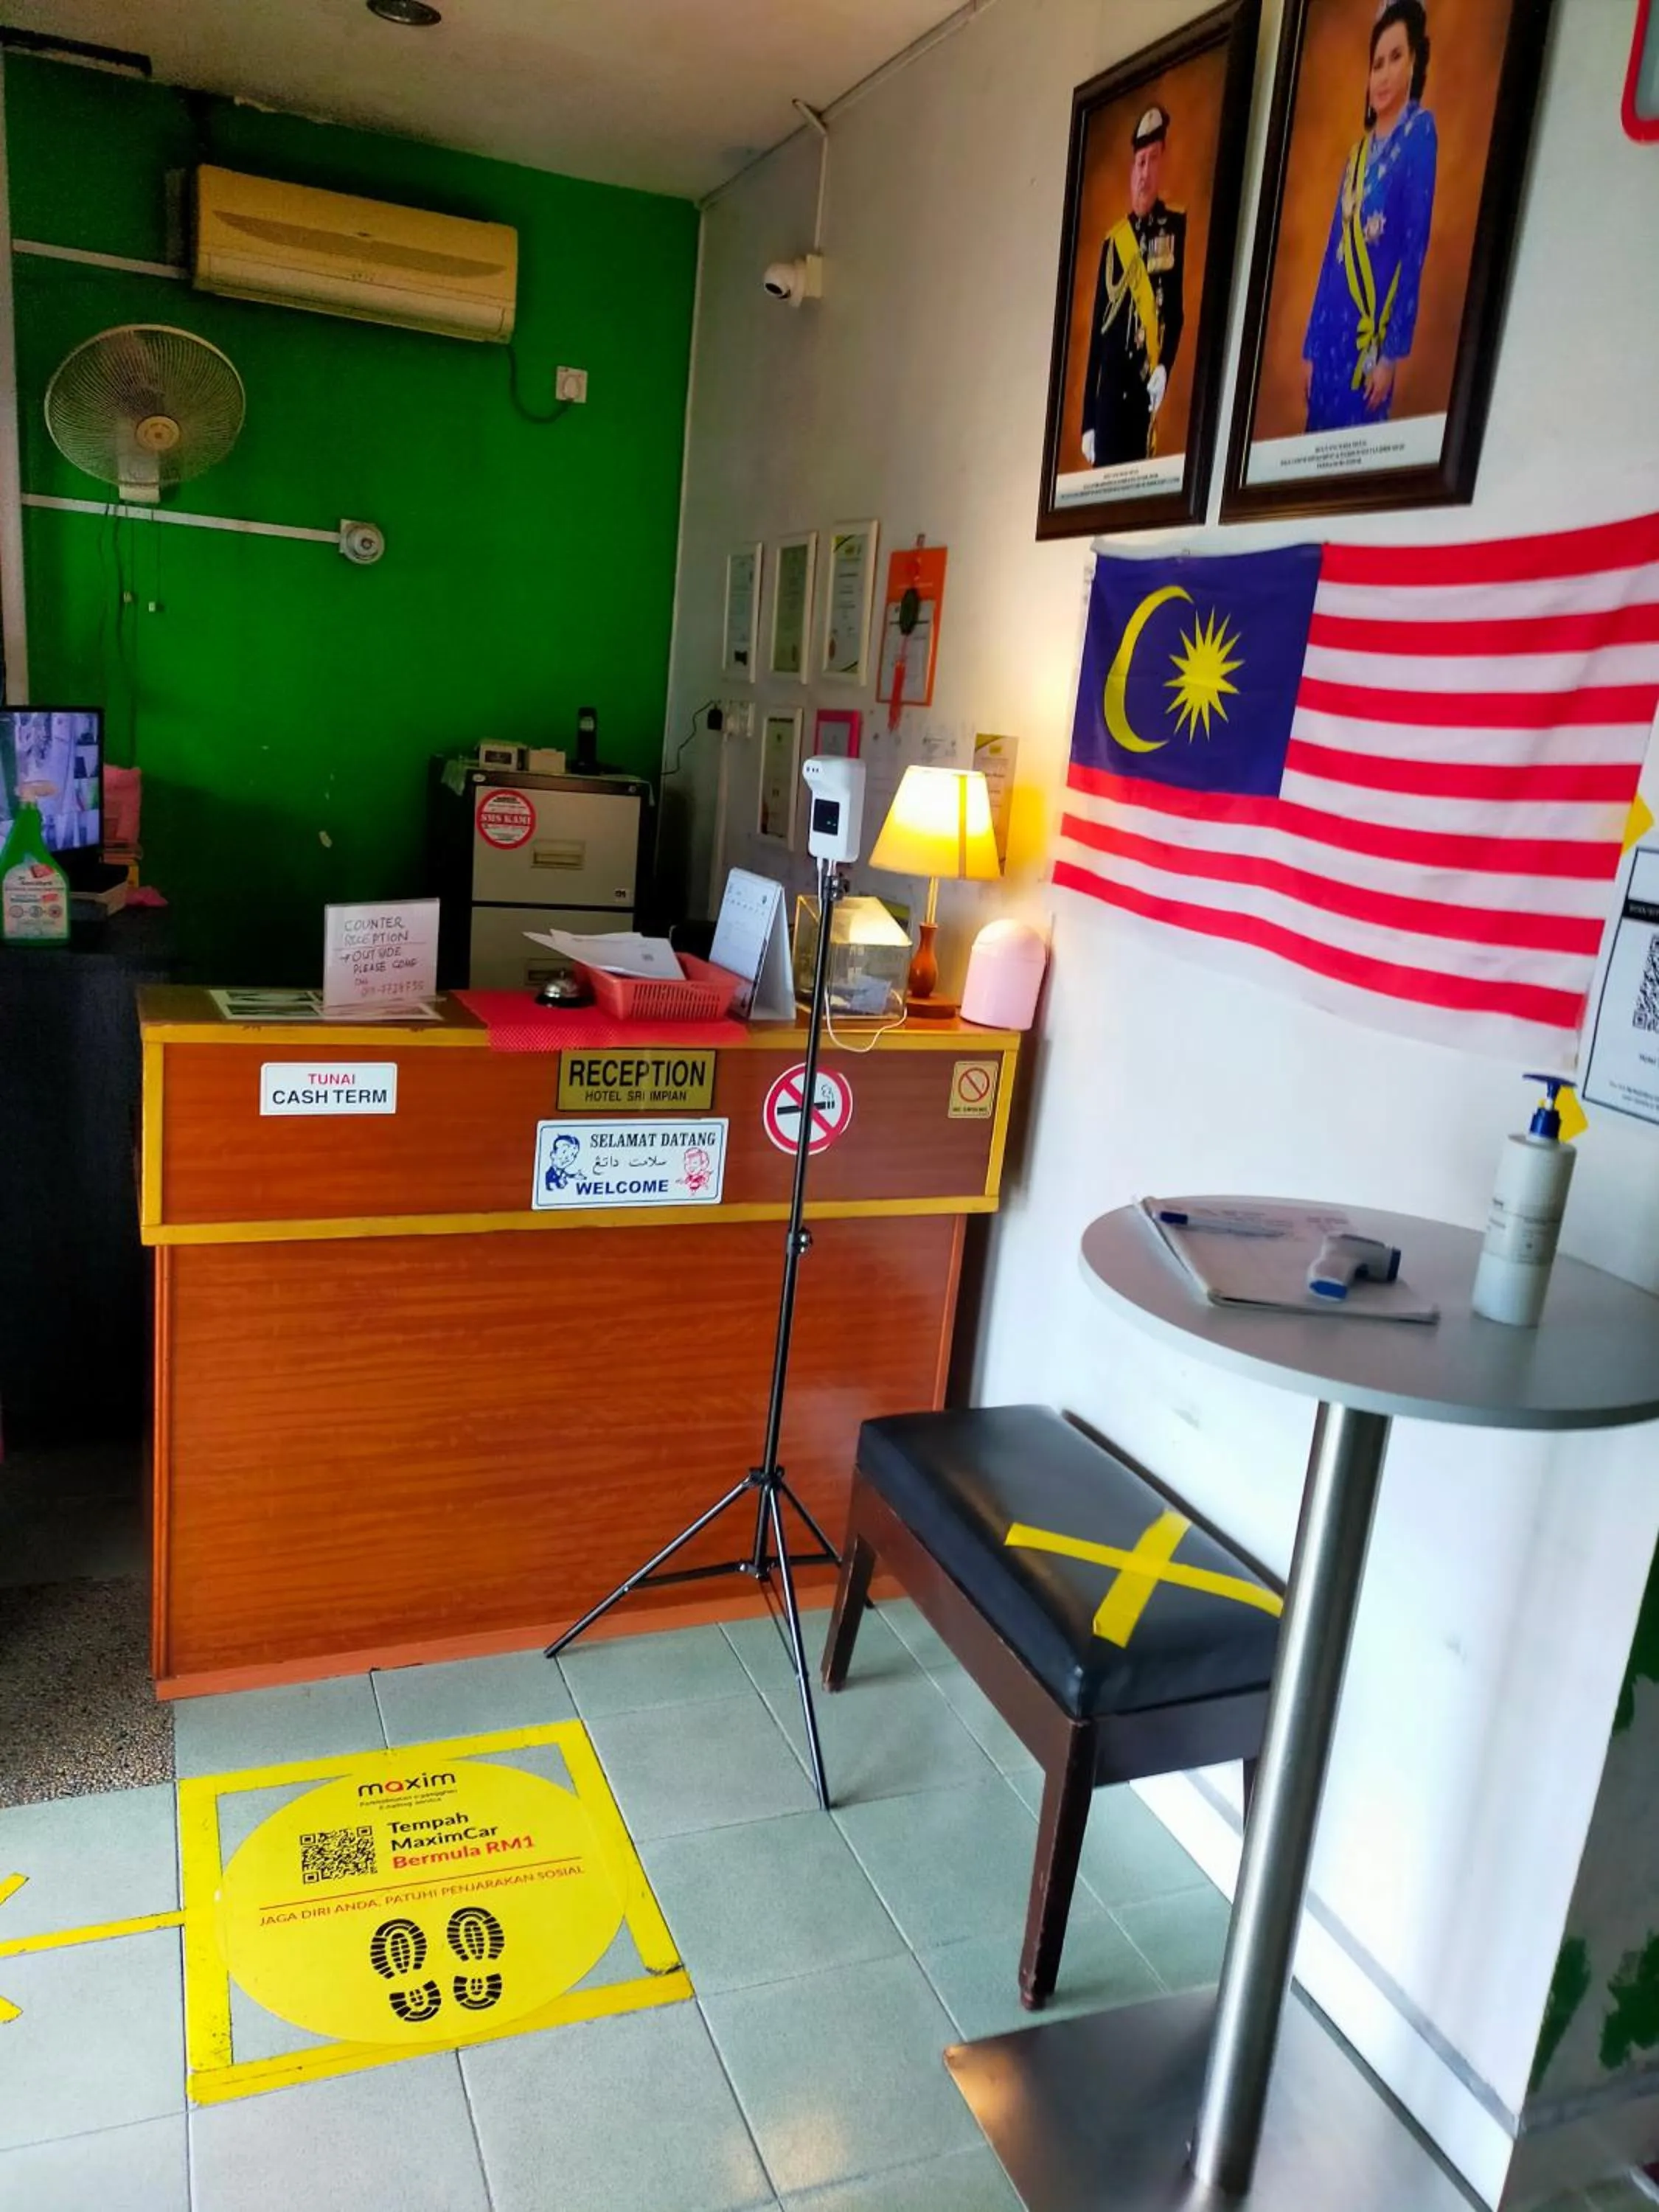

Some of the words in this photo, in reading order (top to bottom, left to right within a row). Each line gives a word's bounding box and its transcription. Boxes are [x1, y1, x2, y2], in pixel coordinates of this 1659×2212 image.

[344, 917, 406, 933] COUNTER
[343, 931, 410, 947] RECEPTION
[353, 961, 387, 974] PLEASE
[308, 1074, 355, 1085] TUNAI
[568, 1060, 706, 1087] RECEPTION
[272, 1090, 328, 1105] CASH
[333, 1089, 388, 1104] TERM
[585, 1091, 622, 1102] HOTEL
[627, 1091, 646, 1102] SRI
[650, 1091, 686, 1102] IMPIAN
[590, 1133, 657, 1148] SELAMAT
[661, 1132, 716, 1147] DATANG
[576, 1180, 669, 1195] WELCOME
[358, 1772, 456, 1797] maxim
[388, 1812, 469, 1834] Tempah
[391, 1826, 498, 1851] MaximCar
[392, 1845, 481, 1869] Bermula
[486, 1835, 534, 1854] RM1
[260, 1912, 297, 1927] JAGA
[302, 1907, 330, 1919] DIRI
[385, 1889, 438, 1905] PATUHI
[442, 1874, 534, 1896] PENJARAKAN
[537, 1865, 585, 1881] SOSIAL
